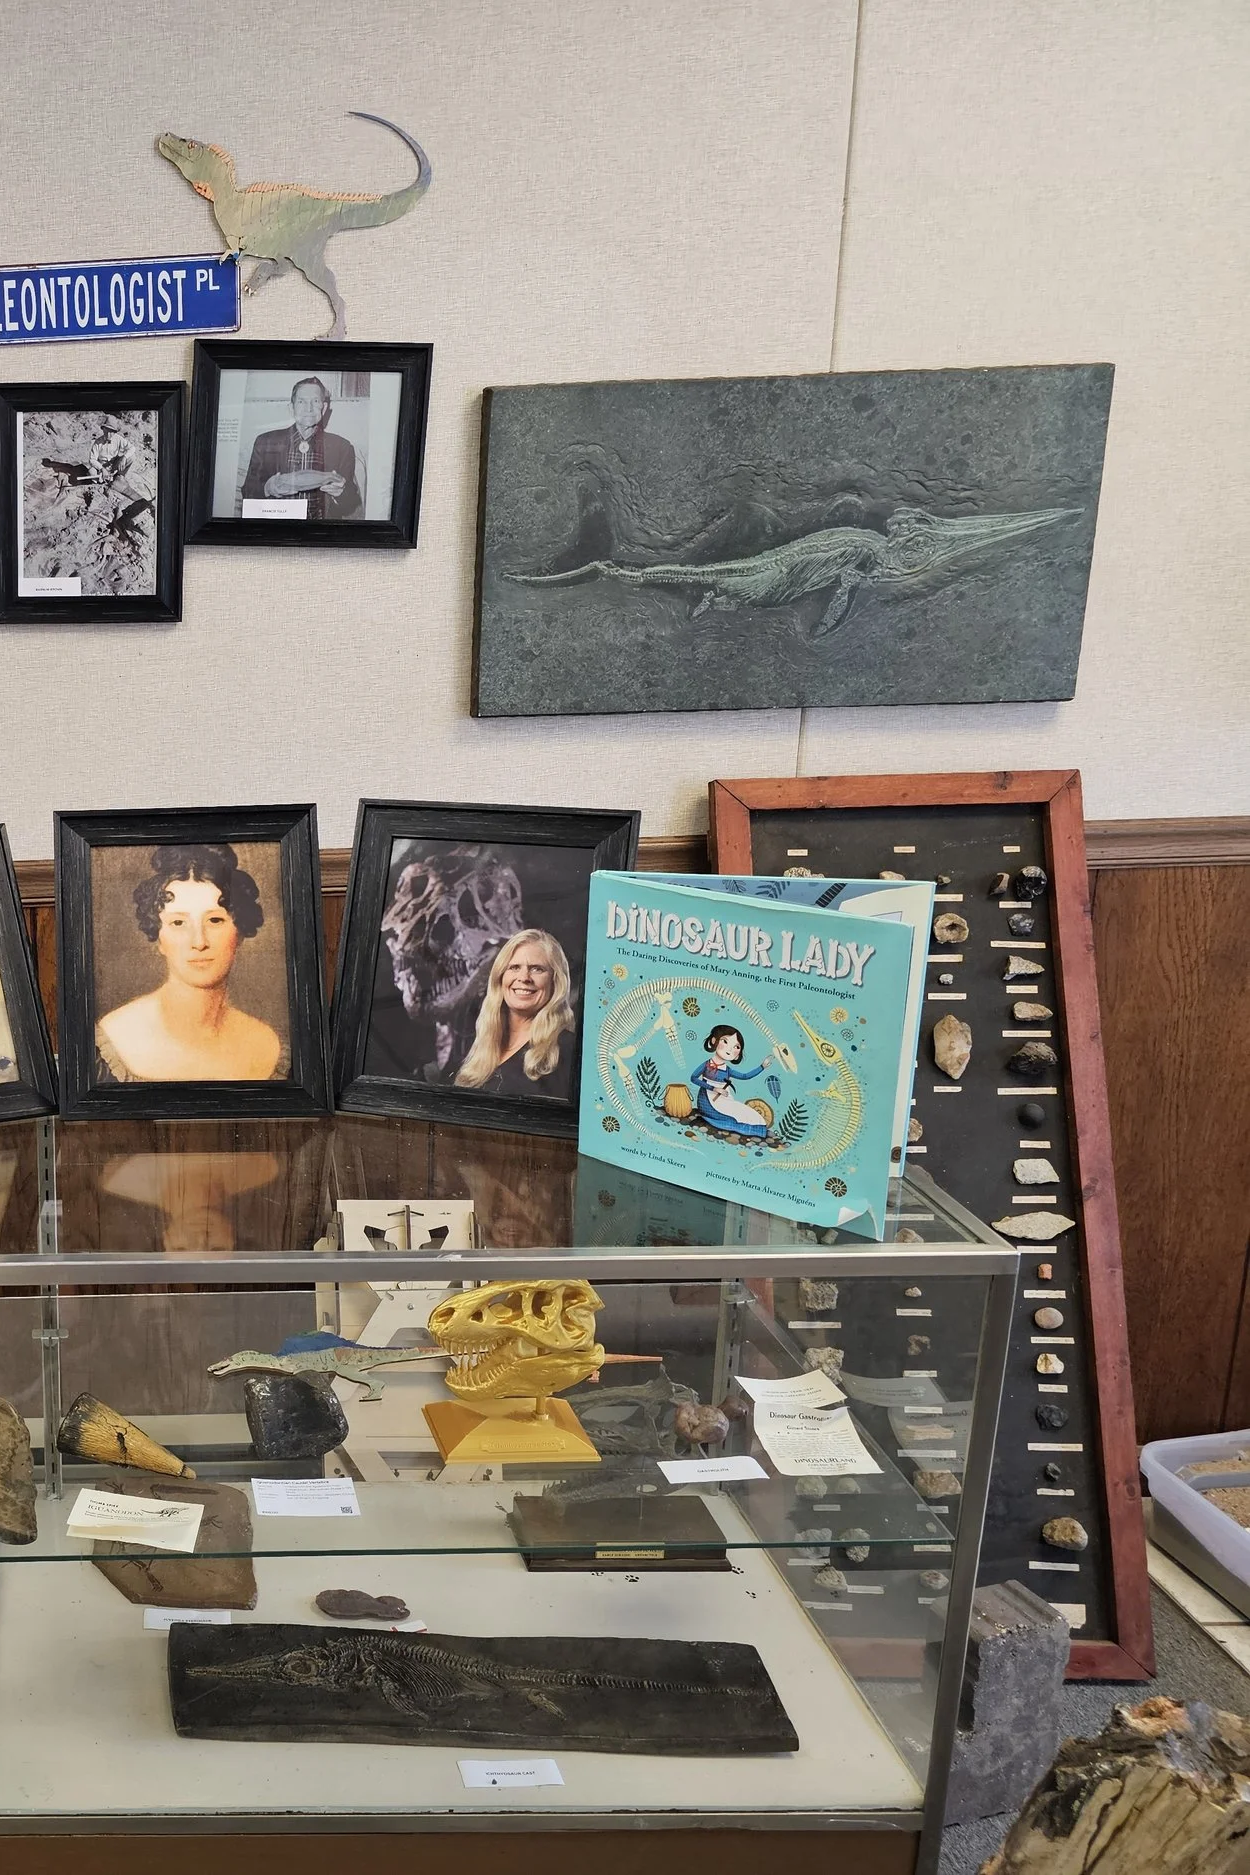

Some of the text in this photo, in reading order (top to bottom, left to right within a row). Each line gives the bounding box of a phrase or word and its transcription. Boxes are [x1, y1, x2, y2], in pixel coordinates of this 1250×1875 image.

[196, 268, 220, 291] PL
[617, 947, 856, 1000] The Daring Discoveries of Mary Anning, the First Paleontologist
[778, 930, 876, 987] LADY
[620, 1145, 686, 1169] words by Linda Skeers
[705, 1170, 816, 1208] pictures by Marta Álvarez Miguéns
[769, 1411, 797, 1419] Dinosaur
